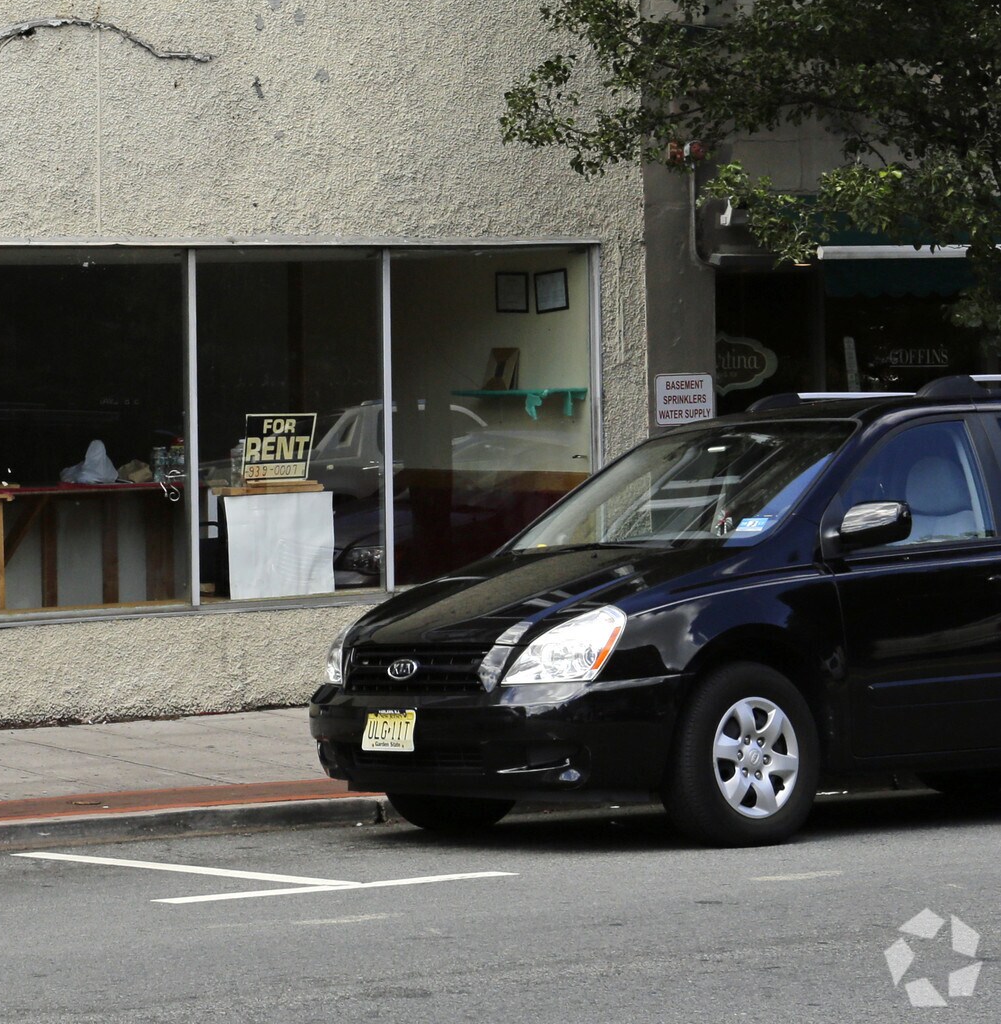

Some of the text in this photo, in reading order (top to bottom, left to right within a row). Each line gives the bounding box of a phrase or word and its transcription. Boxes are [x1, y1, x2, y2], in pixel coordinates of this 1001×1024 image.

[665, 380, 704, 390] BASEMENT
[663, 394, 706, 405] SPRINKLERS
[658, 408, 711, 419] WATER SUPPLY
[262, 418, 297, 434] FOR
[245, 436, 310, 462] RENT
[392, 663, 411, 675] KIA
